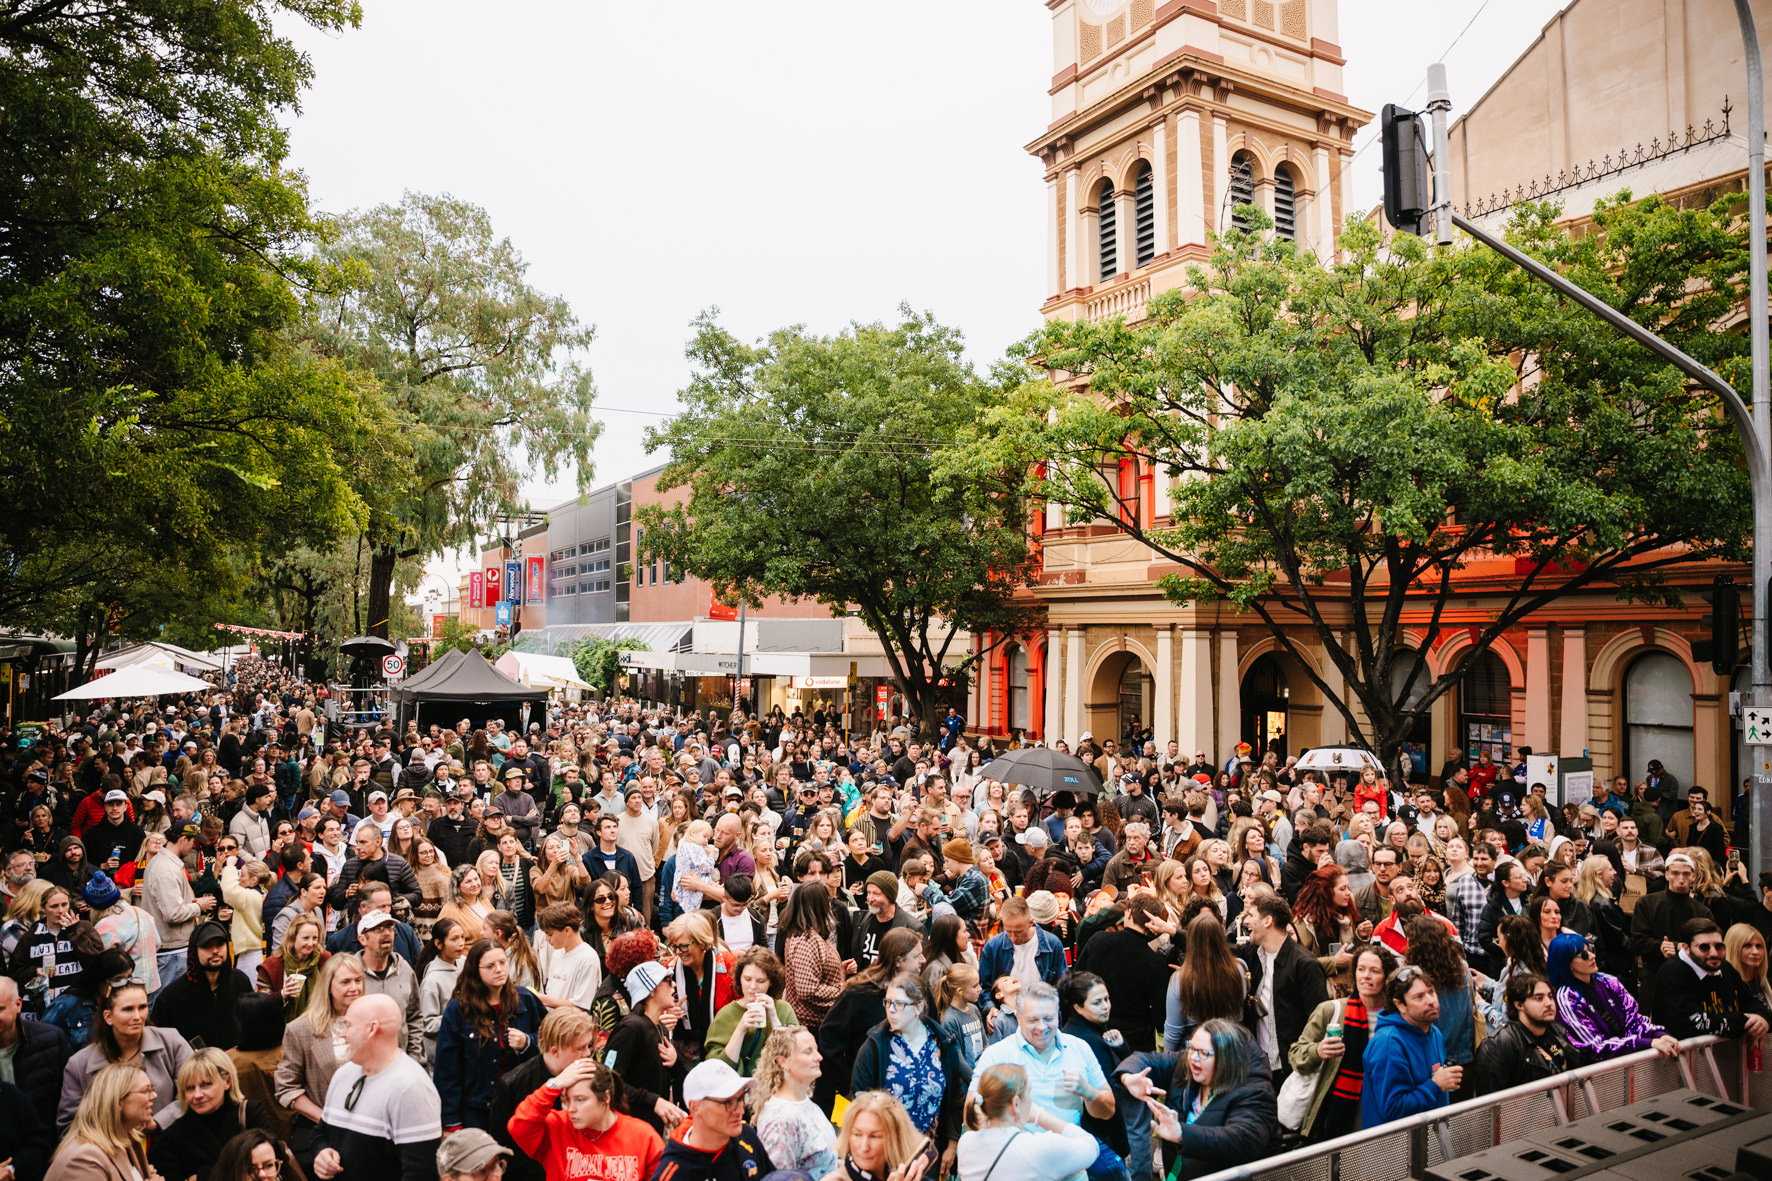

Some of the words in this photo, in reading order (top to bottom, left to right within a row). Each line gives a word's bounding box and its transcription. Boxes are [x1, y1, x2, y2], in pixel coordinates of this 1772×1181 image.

[387, 660, 400, 669] 50
[565, 1146, 604, 1180] TOMMY
[604, 1155, 639, 1181] JEANS
